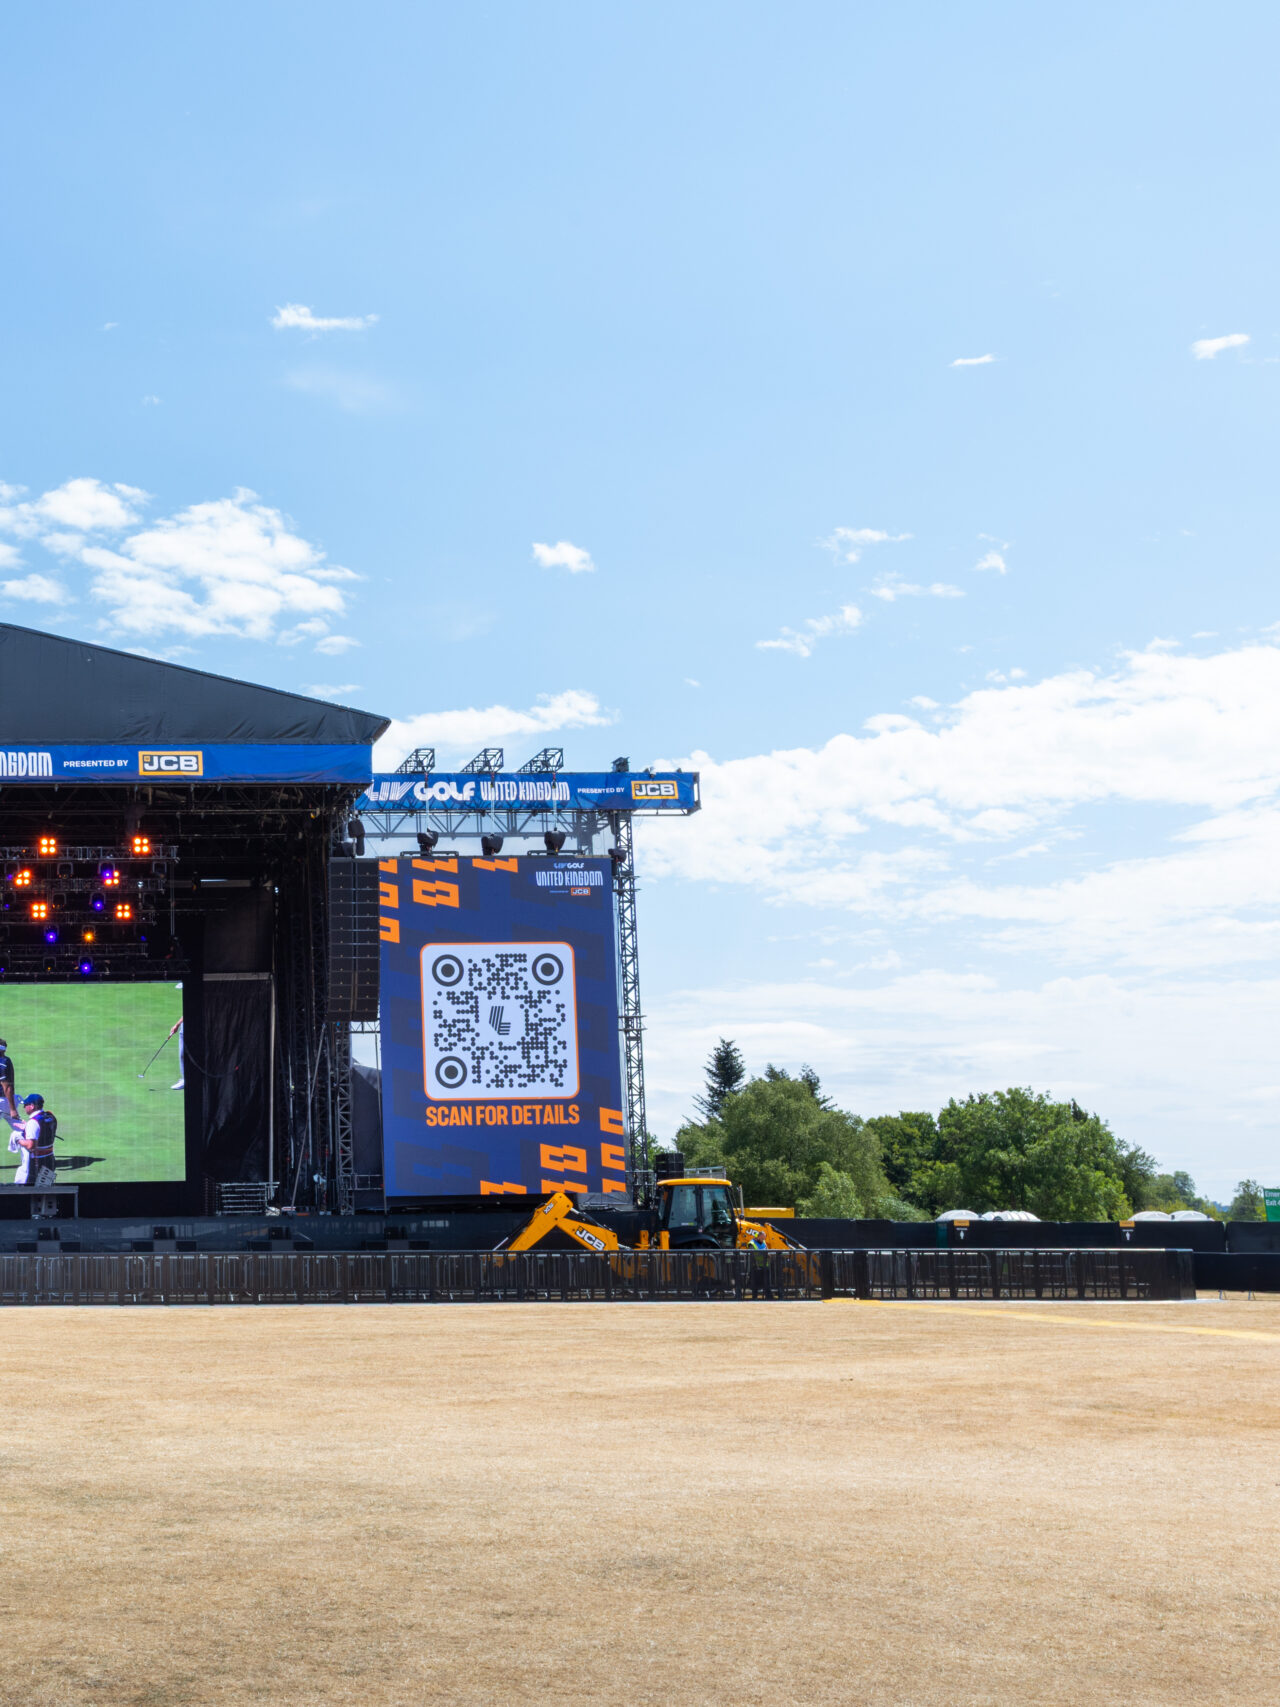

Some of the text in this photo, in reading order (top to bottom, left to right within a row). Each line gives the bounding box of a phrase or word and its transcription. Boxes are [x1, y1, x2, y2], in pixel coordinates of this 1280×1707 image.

[63, 760, 115, 768] PRESENTED
[116, 759, 129, 767] BY
[143, 756, 198, 771] JCB
[364, 781, 415, 801] LIV
[413, 781, 476, 801] GOLF
[480, 781, 517, 801] UNITED
[519, 781, 570, 801] KINGDOM
[635, 784, 674, 796] JCB
[535, 871, 603, 886] UNITED KINGDOM
[426, 1104, 580, 1127] SCAN FOR DETAILS
[575, 1228, 606, 1250] JCB
